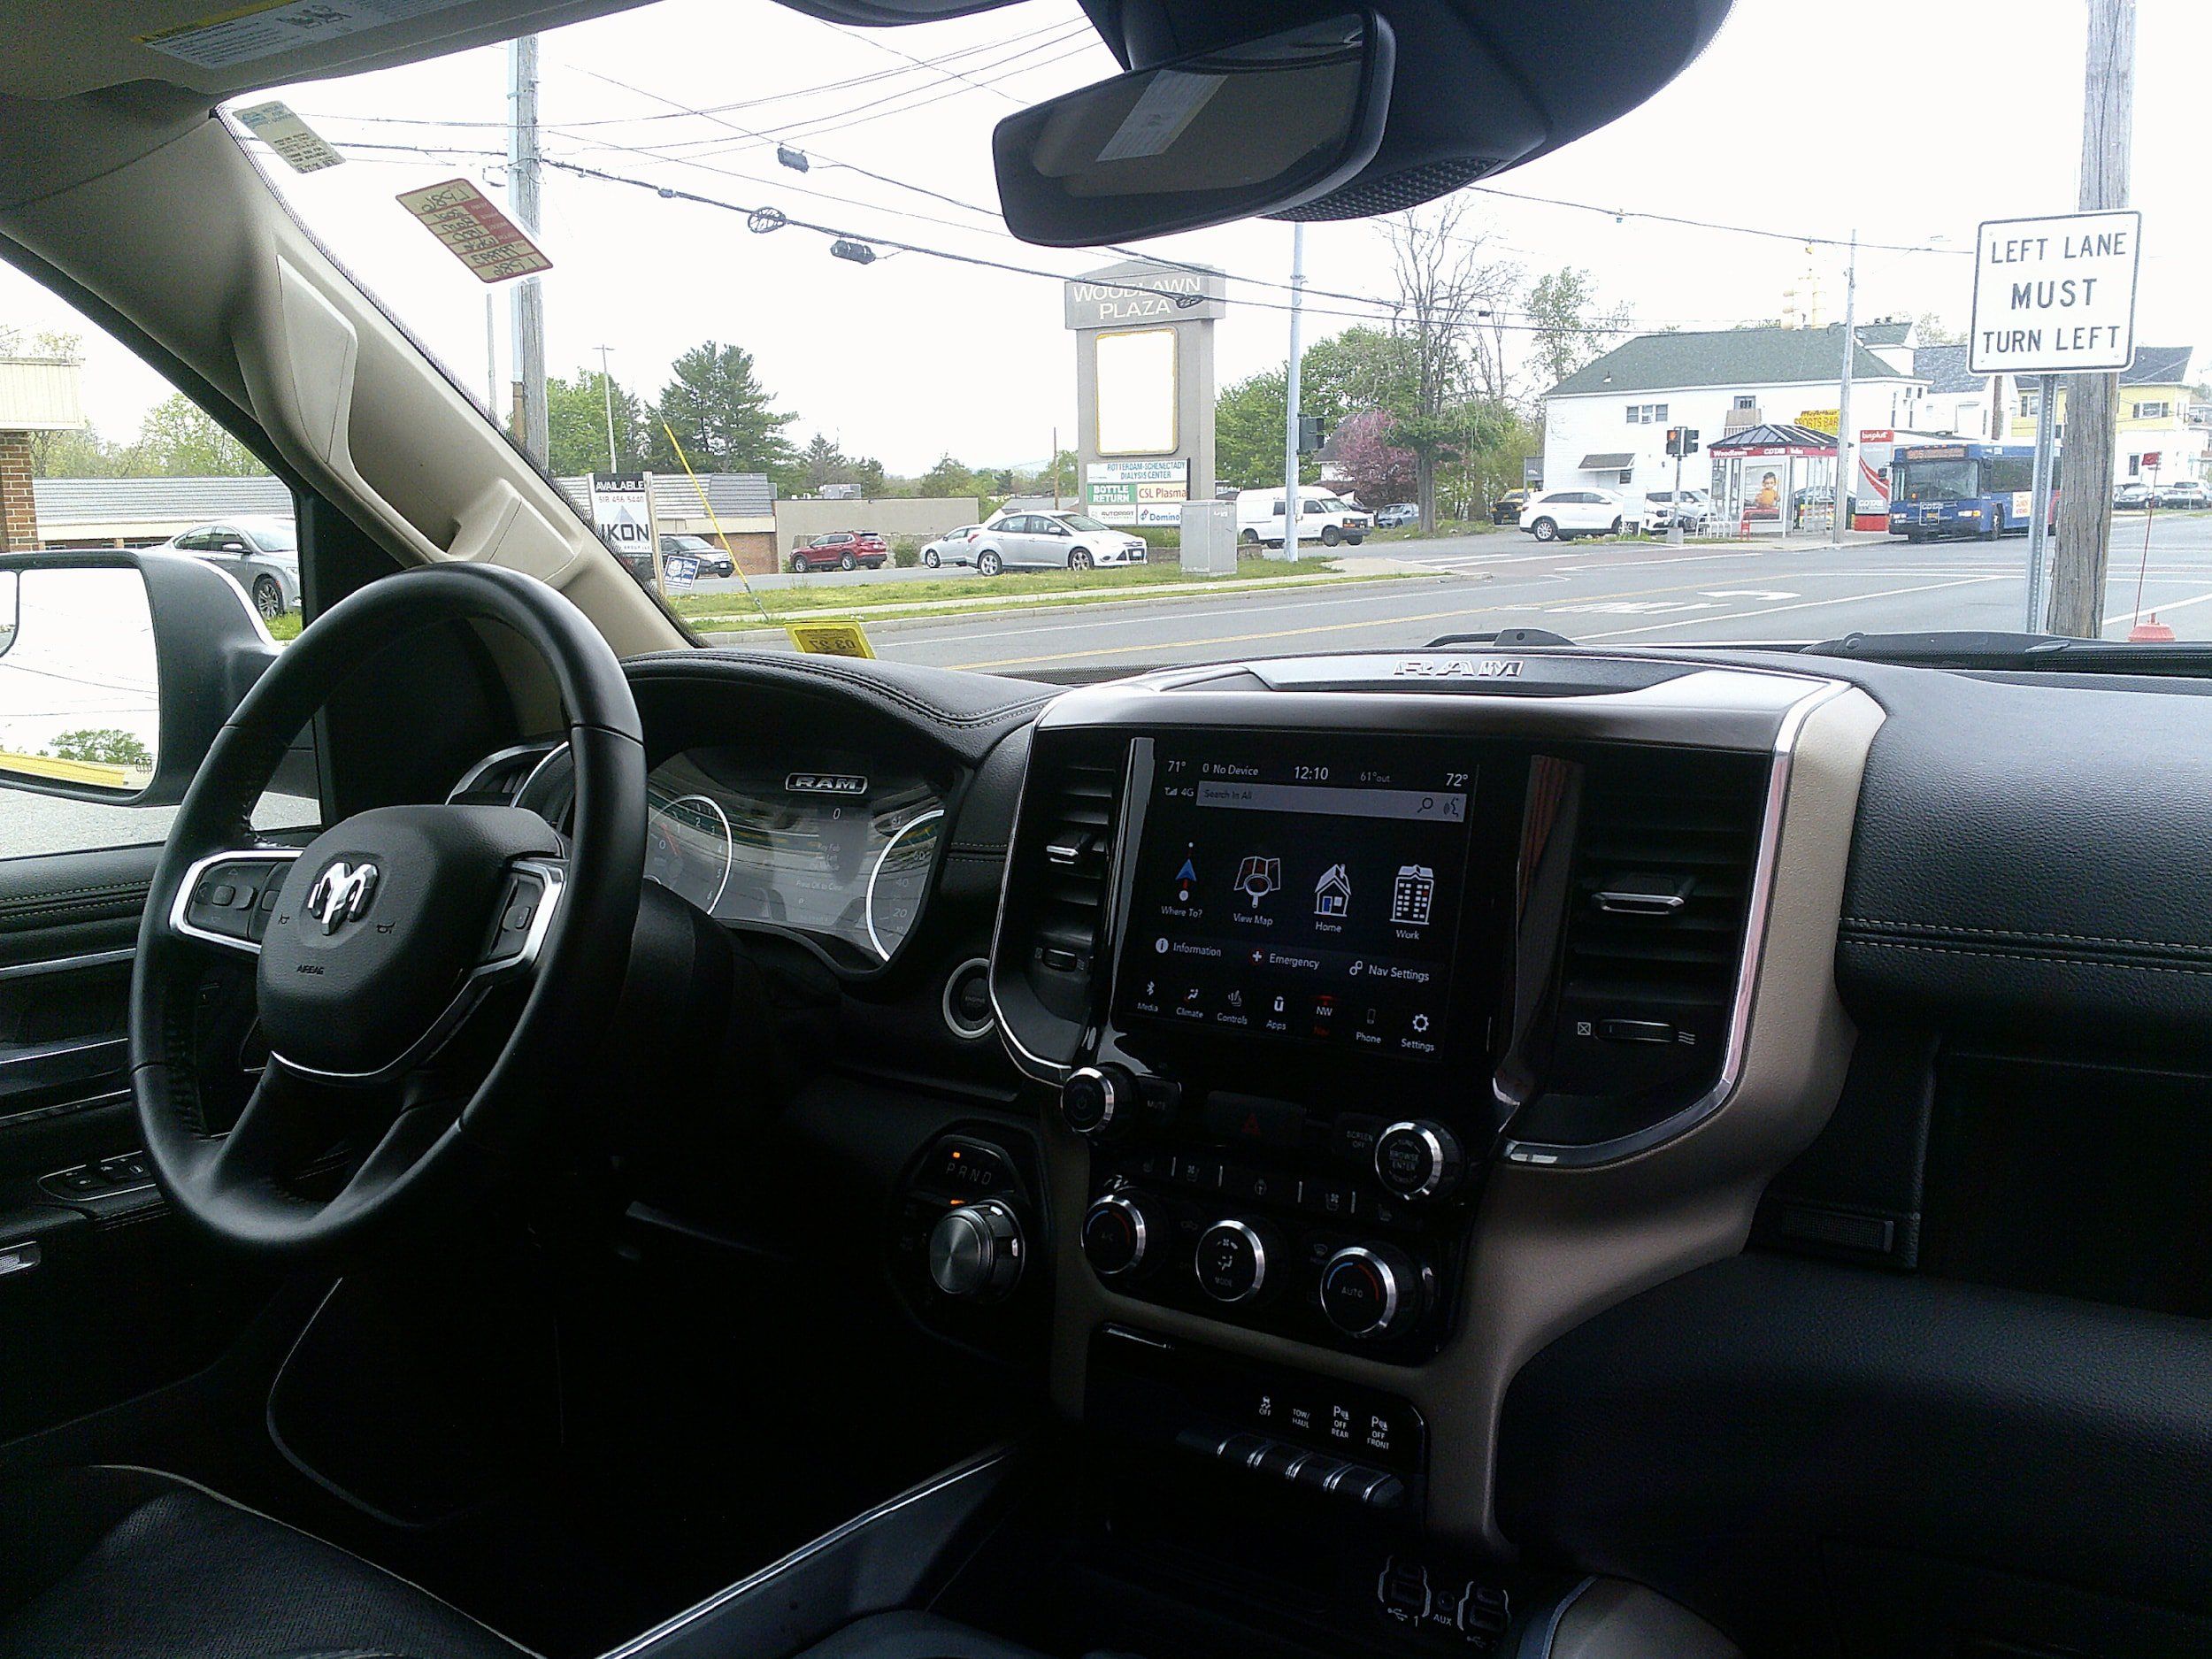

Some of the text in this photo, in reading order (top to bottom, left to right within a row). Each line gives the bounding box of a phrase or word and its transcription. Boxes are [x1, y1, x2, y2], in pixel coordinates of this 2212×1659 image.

[1992, 233, 2127, 264] LEFT LANE
[1073, 277, 1201, 303] WOODLAWN
[2011, 278, 2097, 310] MUST
[1099, 299, 1171, 320] PLAZA
[1983, 326, 2121, 354] TURN LEFT
[1107, 461, 1186, 471] ROTTERDAM-SCHENECTADY
[595, 480, 644, 491] AVAILABLE
[1093, 485, 1129, 494] BOTTLE
[1093, 494, 1130, 503] RETURN
[1139, 488, 1188, 498] CSL Plasma
[1149, 512, 1180, 521] Domino
[602, 524, 649, 541] IKON
[1393, 660, 1524, 677] RAM
[1213, 764, 1226, 775] No
[1228, 764, 1259, 776] Device
[1294, 765, 1329, 780] 12:10
[795, 776, 859, 790] RAM
[1180, 787, 1194, 797] 4G
[893, 908, 908, 918] 20
[1161, 905, 1203, 918] Where To?
[1233, 912, 1273, 927] View Map
[1315, 921, 1342, 933] Home
[1395, 930, 1420, 940] Work
[1172, 941, 1222, 957] Information
[1269, 953, 1320, 971] Emergency
[1368, 964, 1430, 983] Nav Settings
[1176, 1007, 1204, 1018] Climate
[1316, 1005, 1333, 1017] NW
[1217, 1012, 1248, 1025] Controls
[1265, 1019, 1286, 1031] Apps
[1356, 1031, 1382, 1044] Phone
[1401, 1038, 1435, 1053] Settings
[1340, 1286, 1363, 1299] AUTO
[1292, 1417, 1310, 1429] HAUL
[1333, 1419, 1348, 1430] OFF
[1331, 1427, 1349, 1439] REAR
[1371, 1430, 1386, 1440] OFF
[1366, 1437, 1390, 1450] FRONT
[1432, 1613, 1452, 1627] AUX
